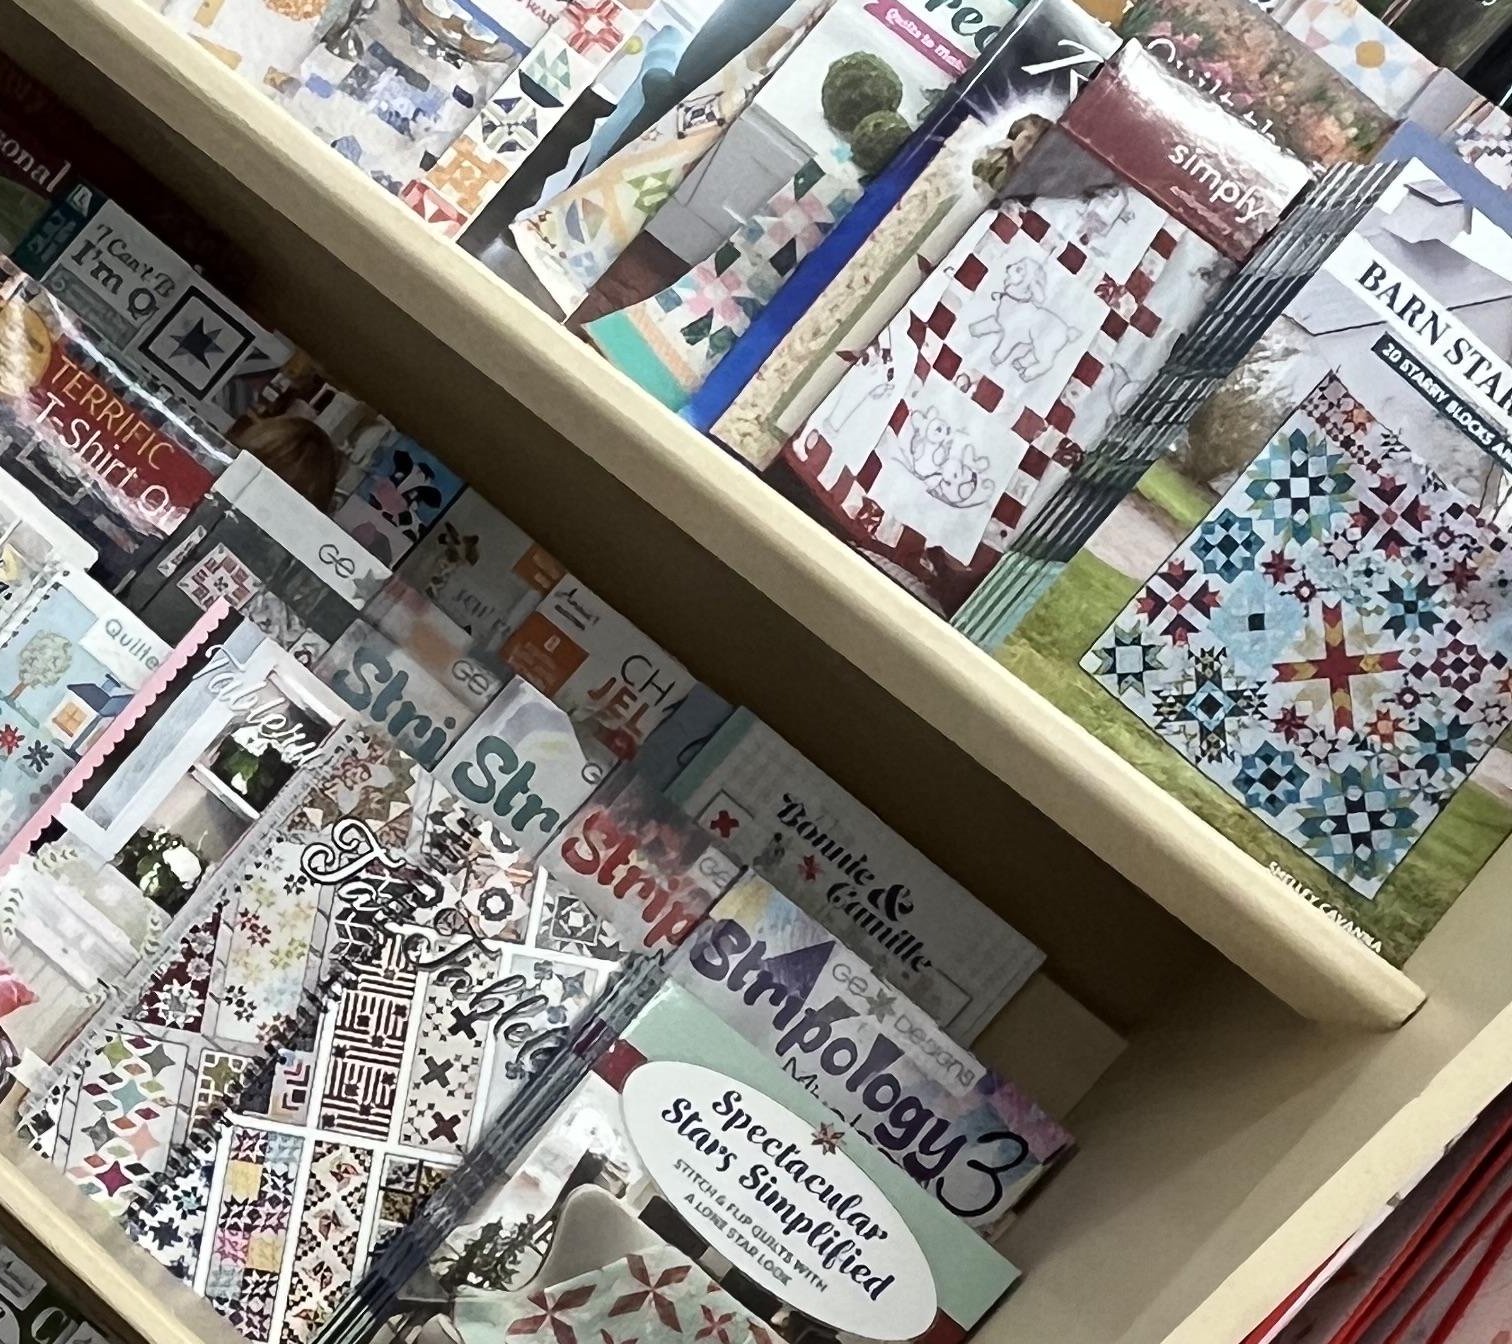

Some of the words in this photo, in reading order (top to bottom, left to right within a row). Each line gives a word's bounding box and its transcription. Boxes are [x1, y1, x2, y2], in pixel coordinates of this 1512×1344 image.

[1354, 260, 1451, 346] BARN
[36, 392, 140, 490] T-Shirt
[50, 355, 176, 471] TERRIFIC
[1382, 342, 1399, 360] 20
[1399, 358, 1445, 407] STARRY
[1444, 397, 1495, 447] BLOCKS
[776, 792, 877, 888] Bonnie
[869, 883, 915, 922] &
[825, 882, 934, 973] Camille
[661, 1097, 738, 1173] Stars
[738, 1163, 896, 1302] Simplified
[712, 1090, 889, 1243] Spectacular
[673, 1158, 717, 1200] STITCH
[727, 1204, 754, 1228] FLIP
[751, 1227, 795, 1265] QUILTS
[794, 1259, 828, 1293] WITH
[683, 1192, 695, 1206] A
[694, 1205, 727, 1234] LONE
[726, 1229, 759, 1258] STAR
[757, 1256, 793, 1288] LOOK
